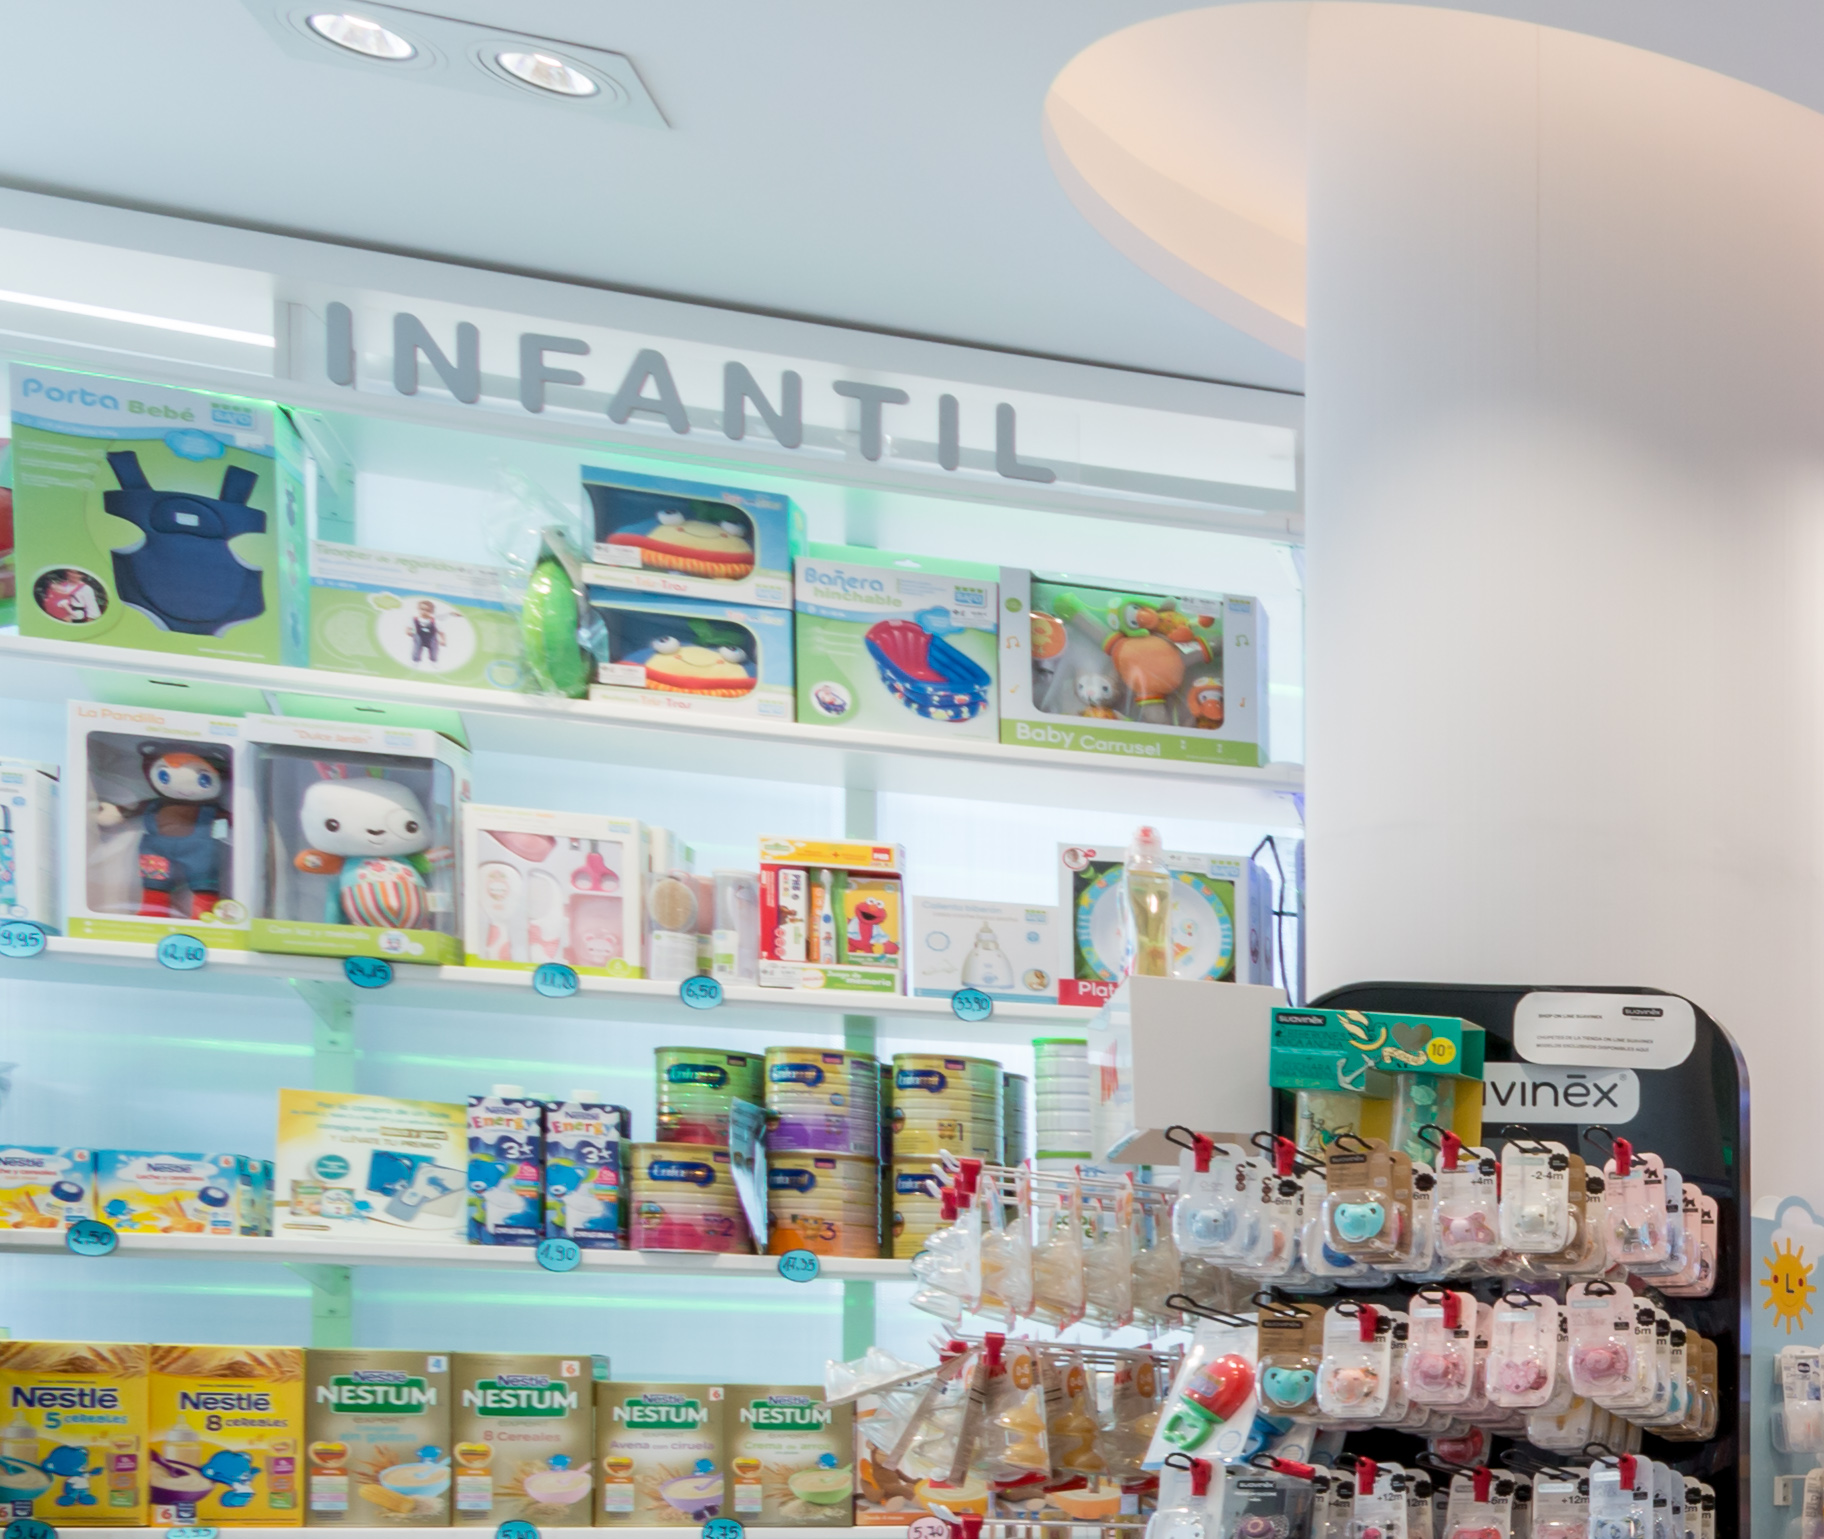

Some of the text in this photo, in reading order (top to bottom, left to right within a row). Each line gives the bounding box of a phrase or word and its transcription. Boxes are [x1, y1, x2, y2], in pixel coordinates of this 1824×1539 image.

[22, 377, 195, 424] Porta Bebé
[326, 300, 1057, 484] INFANTIL
[804, 567, 884, 592] Bañera
[1016, 723, 1074, 747] Baby
[316, 1385, 437, 1408] NESTUM
[463, 1389, 578, 1411] NESTUM
[613, 1406, 708, 1424] NESTUM
[740, 1408, 832, 1425] NESTUM
